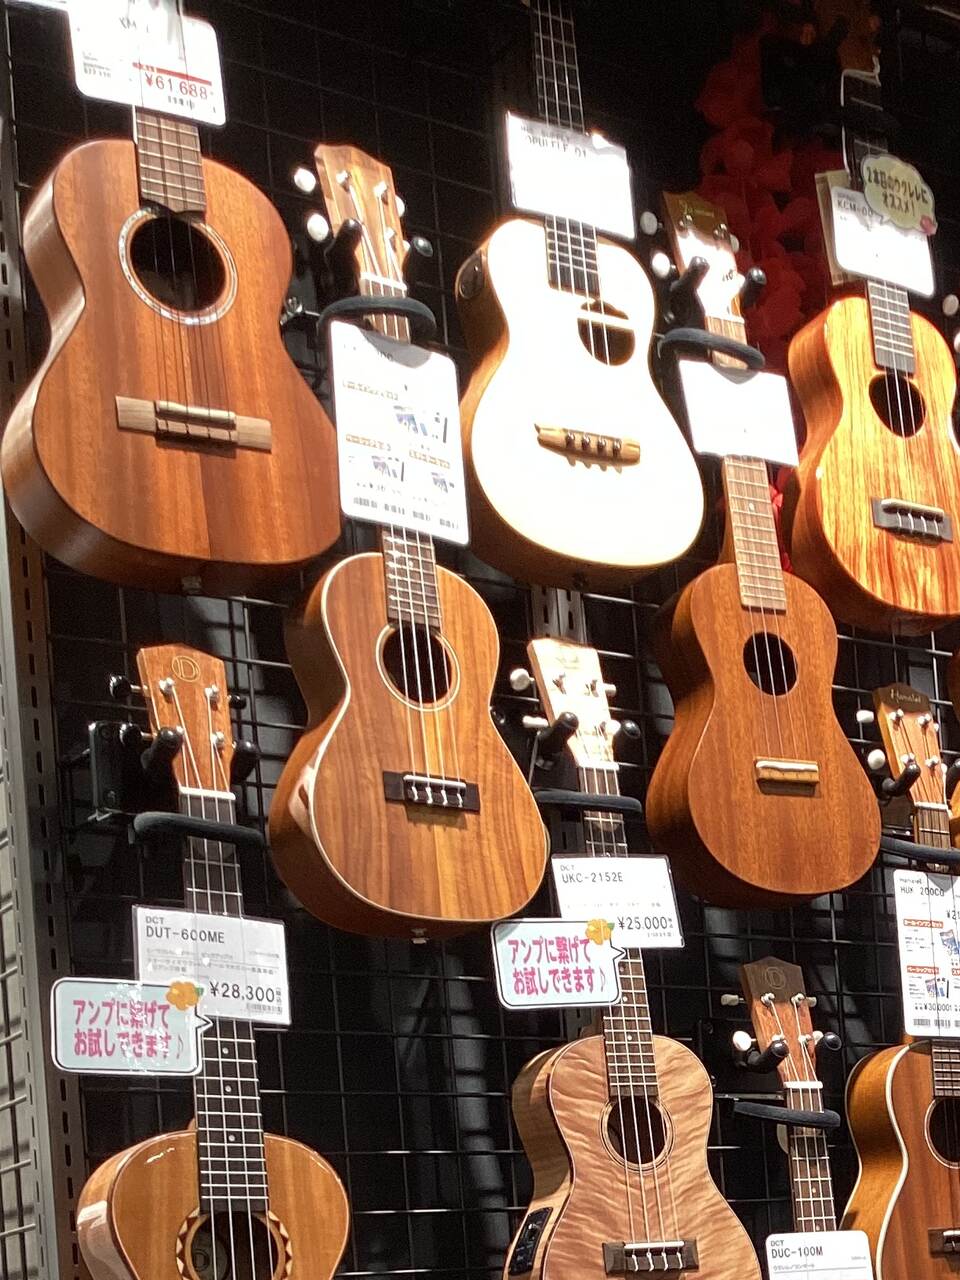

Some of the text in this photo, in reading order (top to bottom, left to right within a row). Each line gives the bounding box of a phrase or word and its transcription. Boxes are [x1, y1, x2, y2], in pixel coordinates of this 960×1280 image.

[561, 871, 624, 884] UKC-2152E
[145, 916, 164, 925] DCT
[145, 925, 226, 944] DUT-600ME
[507, 935, 593, 964] アンプに繋げて
[210, 981, 275, 1004] ¥28,300
[770, 1239, 785, 1247] DCT
[771, 1246, 824, 1259] DUC-100M
